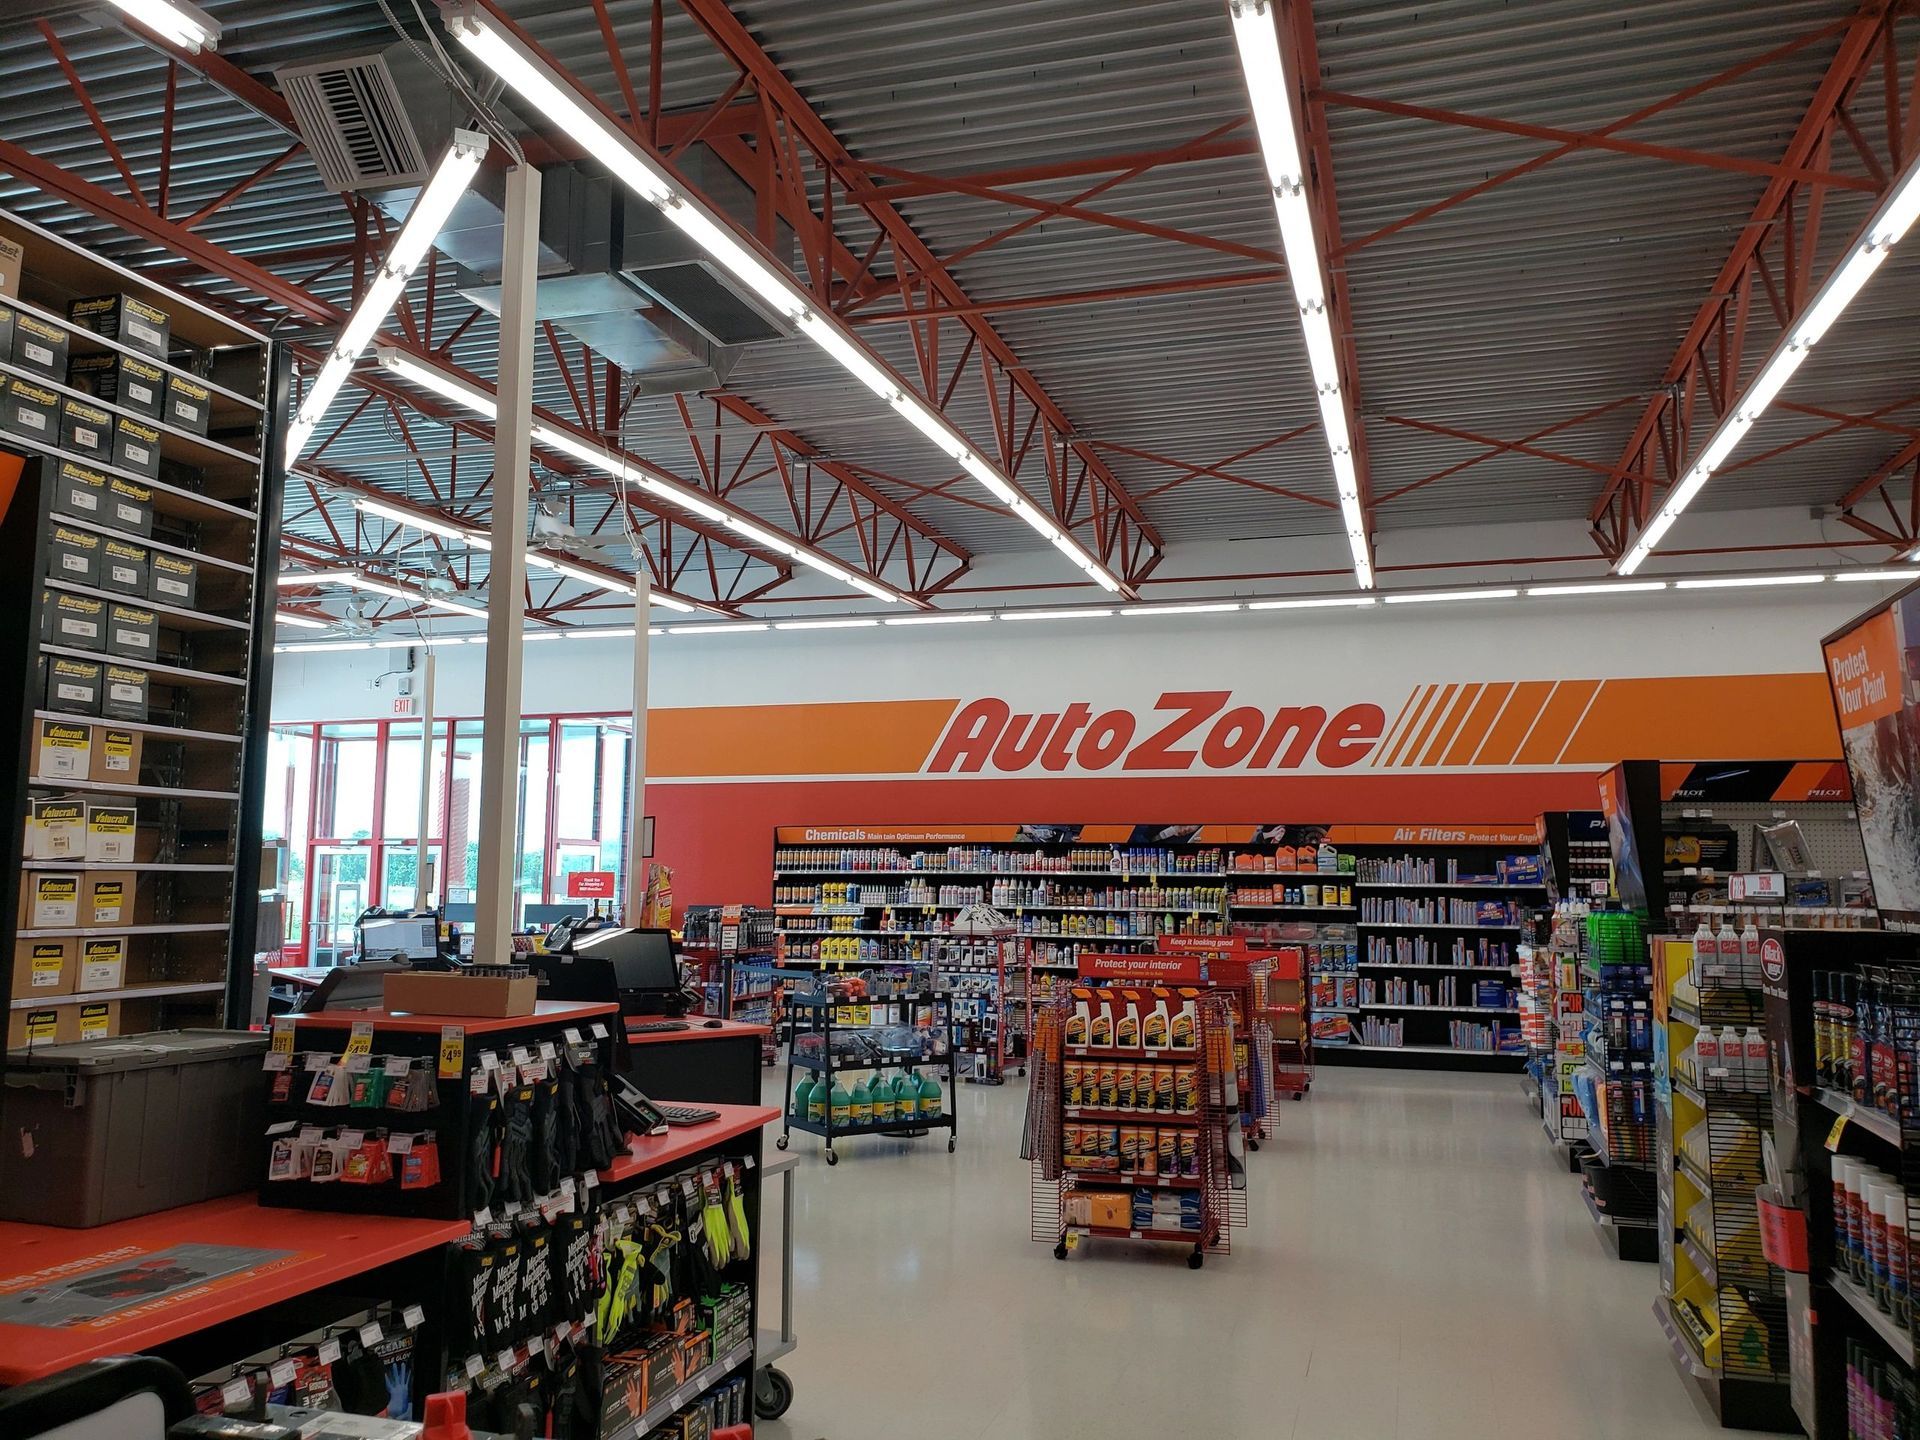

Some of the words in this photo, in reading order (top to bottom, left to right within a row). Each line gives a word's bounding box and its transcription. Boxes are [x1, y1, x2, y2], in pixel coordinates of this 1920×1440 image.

[126, 300, 166, 323] Duralast
[19, 316, 65, 341] Duralast
[122, 358, 163, 379] Duralast
[11, 381, 59, 402] Duralast
[171, 377, 209, 398] Duralast
[65, 401, 110, 423] Duralast
[63, 463, 106, 484] Duralast
[111, 479, 152, 498] Duralast
[56, 527, 99, 545] Duralast
[106, 541, 147, 560] Duralast
[59, 595, 102, 610] Duralast
[1832, 645, 1870, 685] Protect
[1838, 686, 1863, 714] Your
[1862, 671, 1887, 706] Paint
[394, 699, 410, 713] EXIT
[926, 690, 1385, 773] AutoZone
[1671, 789, 1705, 797] PILOT
[1807, 789, 1843, 797] PILOT
[805, 828, 866, 842] Chemicals
[896, 832, 924, 842] Optimum
[925, 832, 966, 841] Performance
[1394, 828, 1416, 841] Air
[1418, 828, 1466, 841] Filters
[1469, 833, 1498, 842] Protect
[1499, 834, 1516, 842] Your
[1170, 937, 1187, 947] Keep
[1188, 937, 1192, 946] it
[1193, 937, 1216, 947] looking
[1216, 939, 1234, 947] good
[1094, 958, 1127, 969] Protect
[1128, 961, 1148, 970] your
[1149, 959, 1182, 970] interior
[273, 1043, 286, 1051] GET
[274, 1036, 287, 1044] BUY
[90, 1314, 122, 1328] GET
[121, 1308, 140, 1319] IN
[140, 1298, 172, 1313] THE
